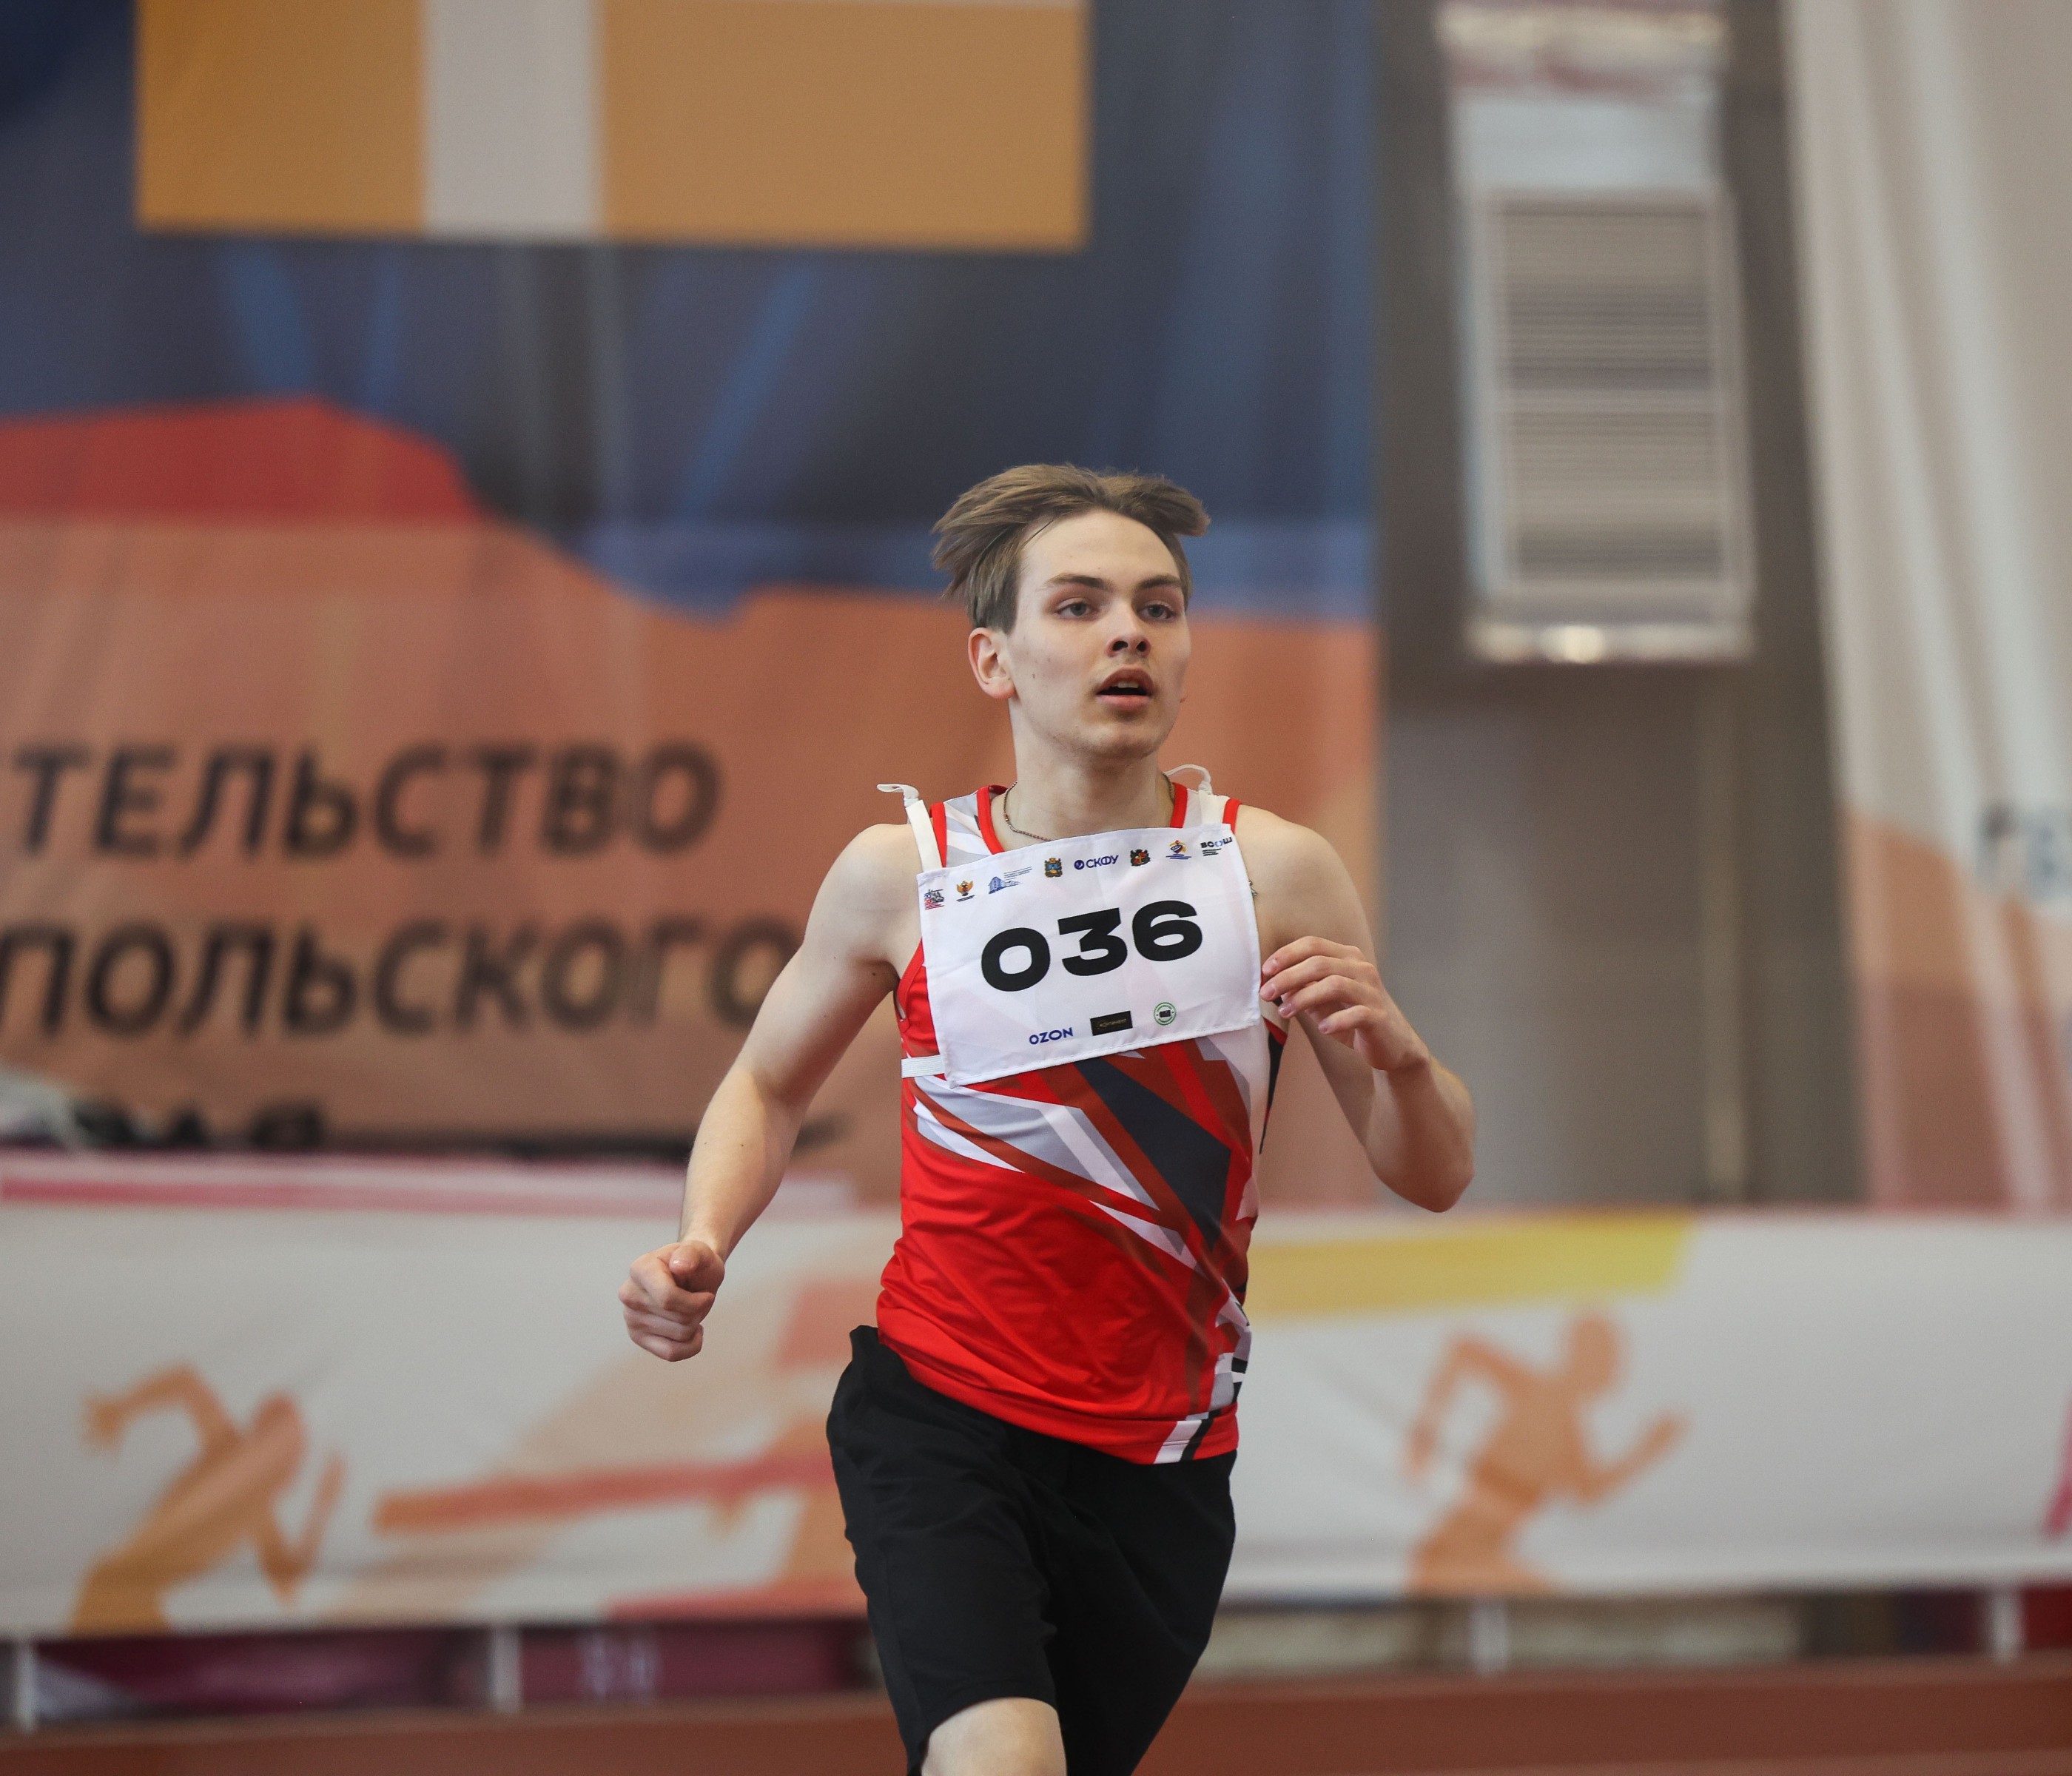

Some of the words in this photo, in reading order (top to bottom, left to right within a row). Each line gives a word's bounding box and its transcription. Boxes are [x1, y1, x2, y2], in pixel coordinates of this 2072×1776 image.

[13, 743, 722, 857] ТЕЛЬСТВО
[1086, 854, 1119, 868] СКФУ
[981, 900, 1202, 992] 036
[1029, 1027, 1073, 1045] OZON
